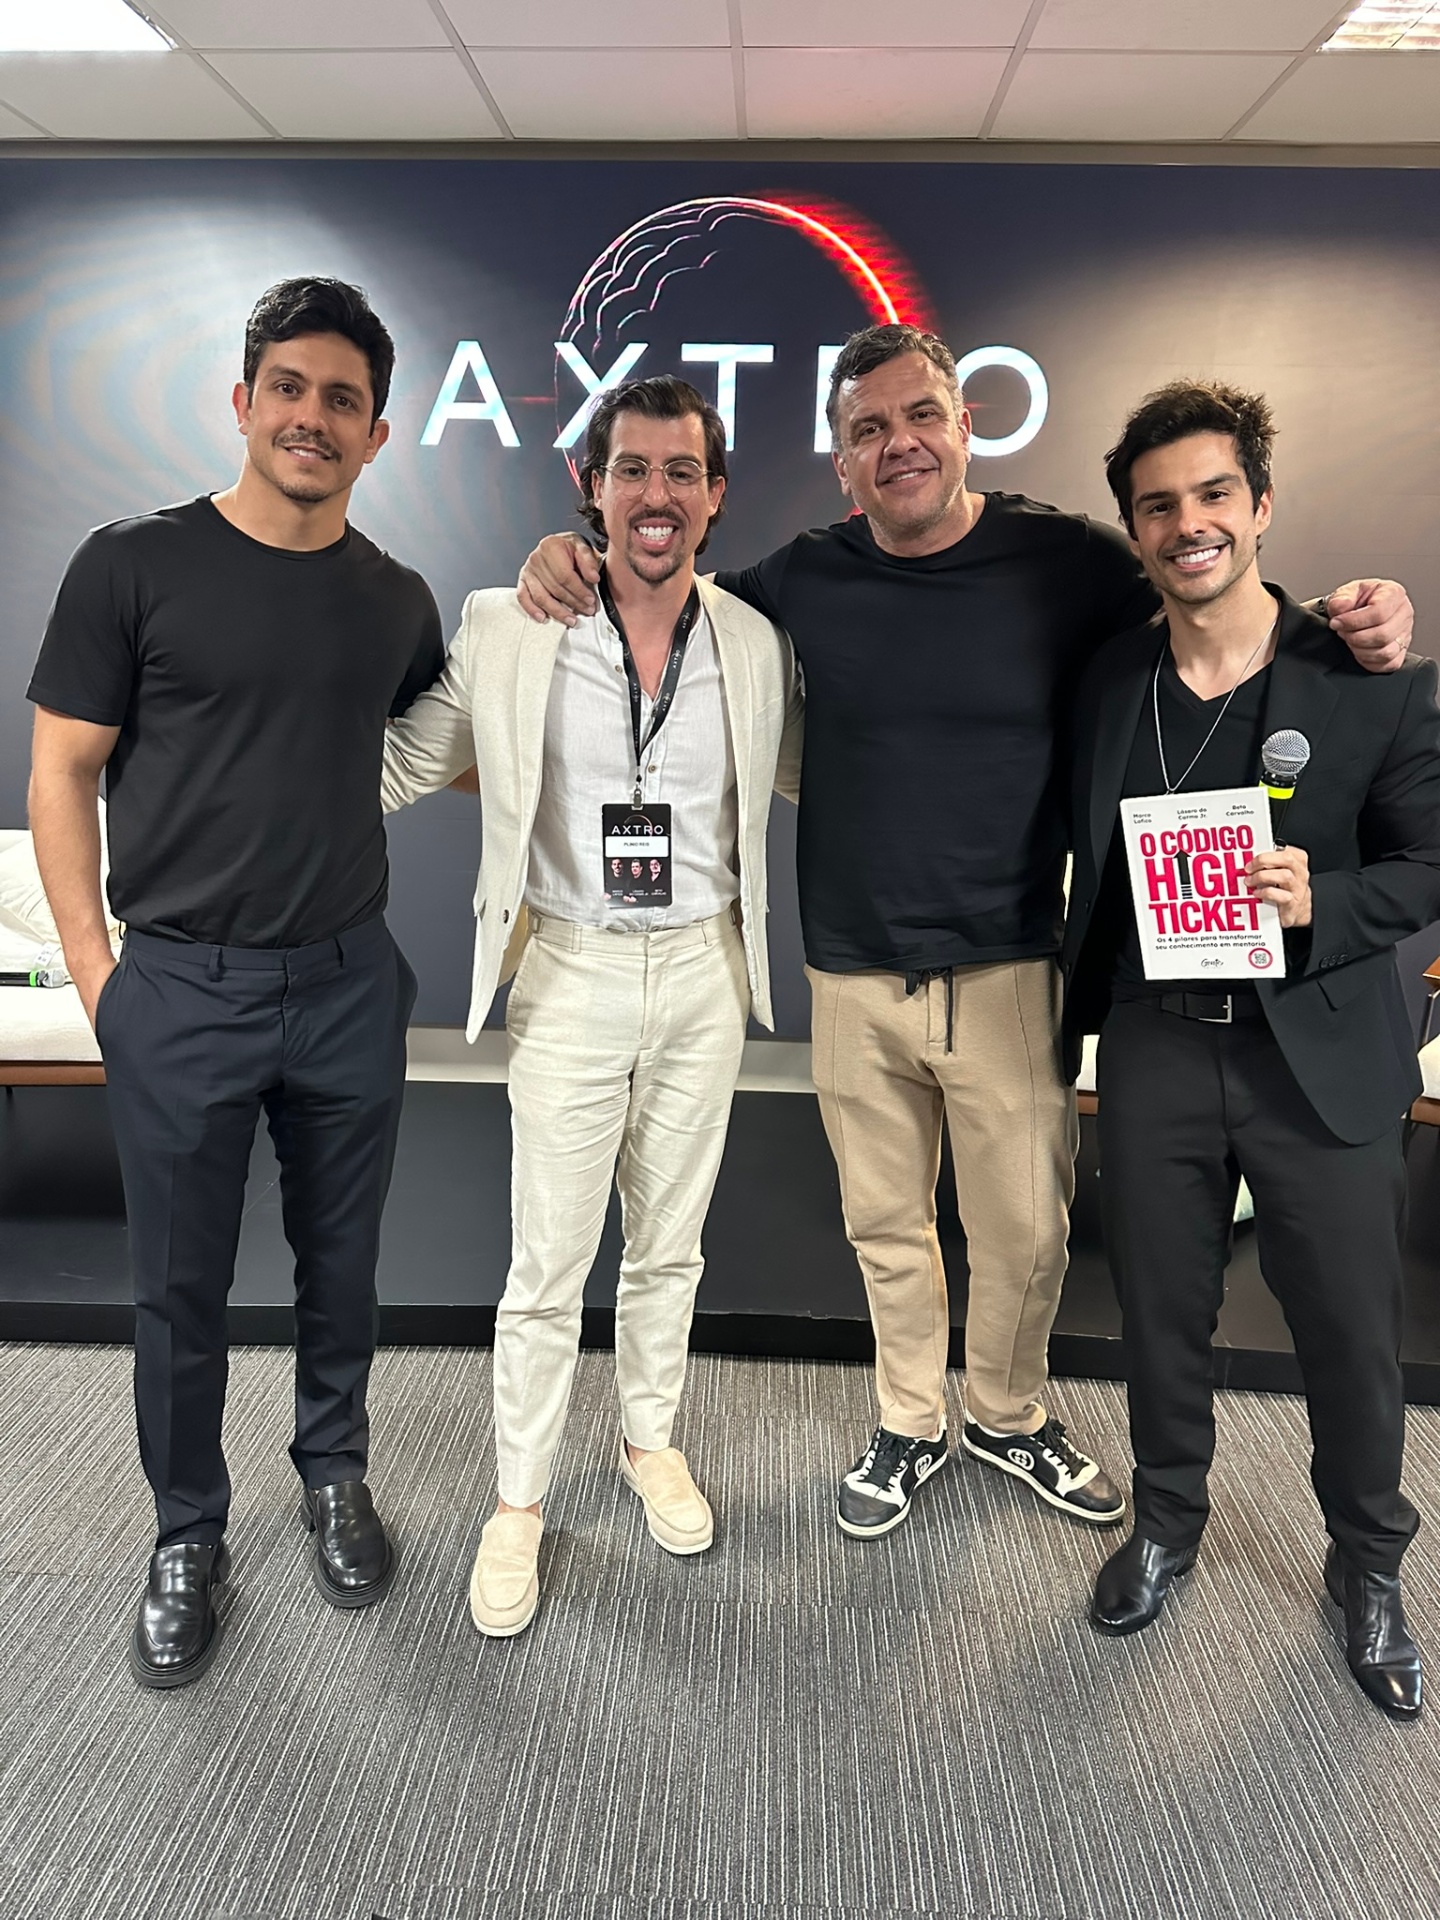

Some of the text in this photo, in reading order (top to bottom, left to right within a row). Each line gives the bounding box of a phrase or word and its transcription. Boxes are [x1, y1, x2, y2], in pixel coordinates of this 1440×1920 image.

[611, 825, 664, 835] AXTRO
[1140, 823, 1254, 857] O CÓDIGO
[1144, 850, 1256, 902] HIGH
[1148, 897, 1264, 935] TICKET
